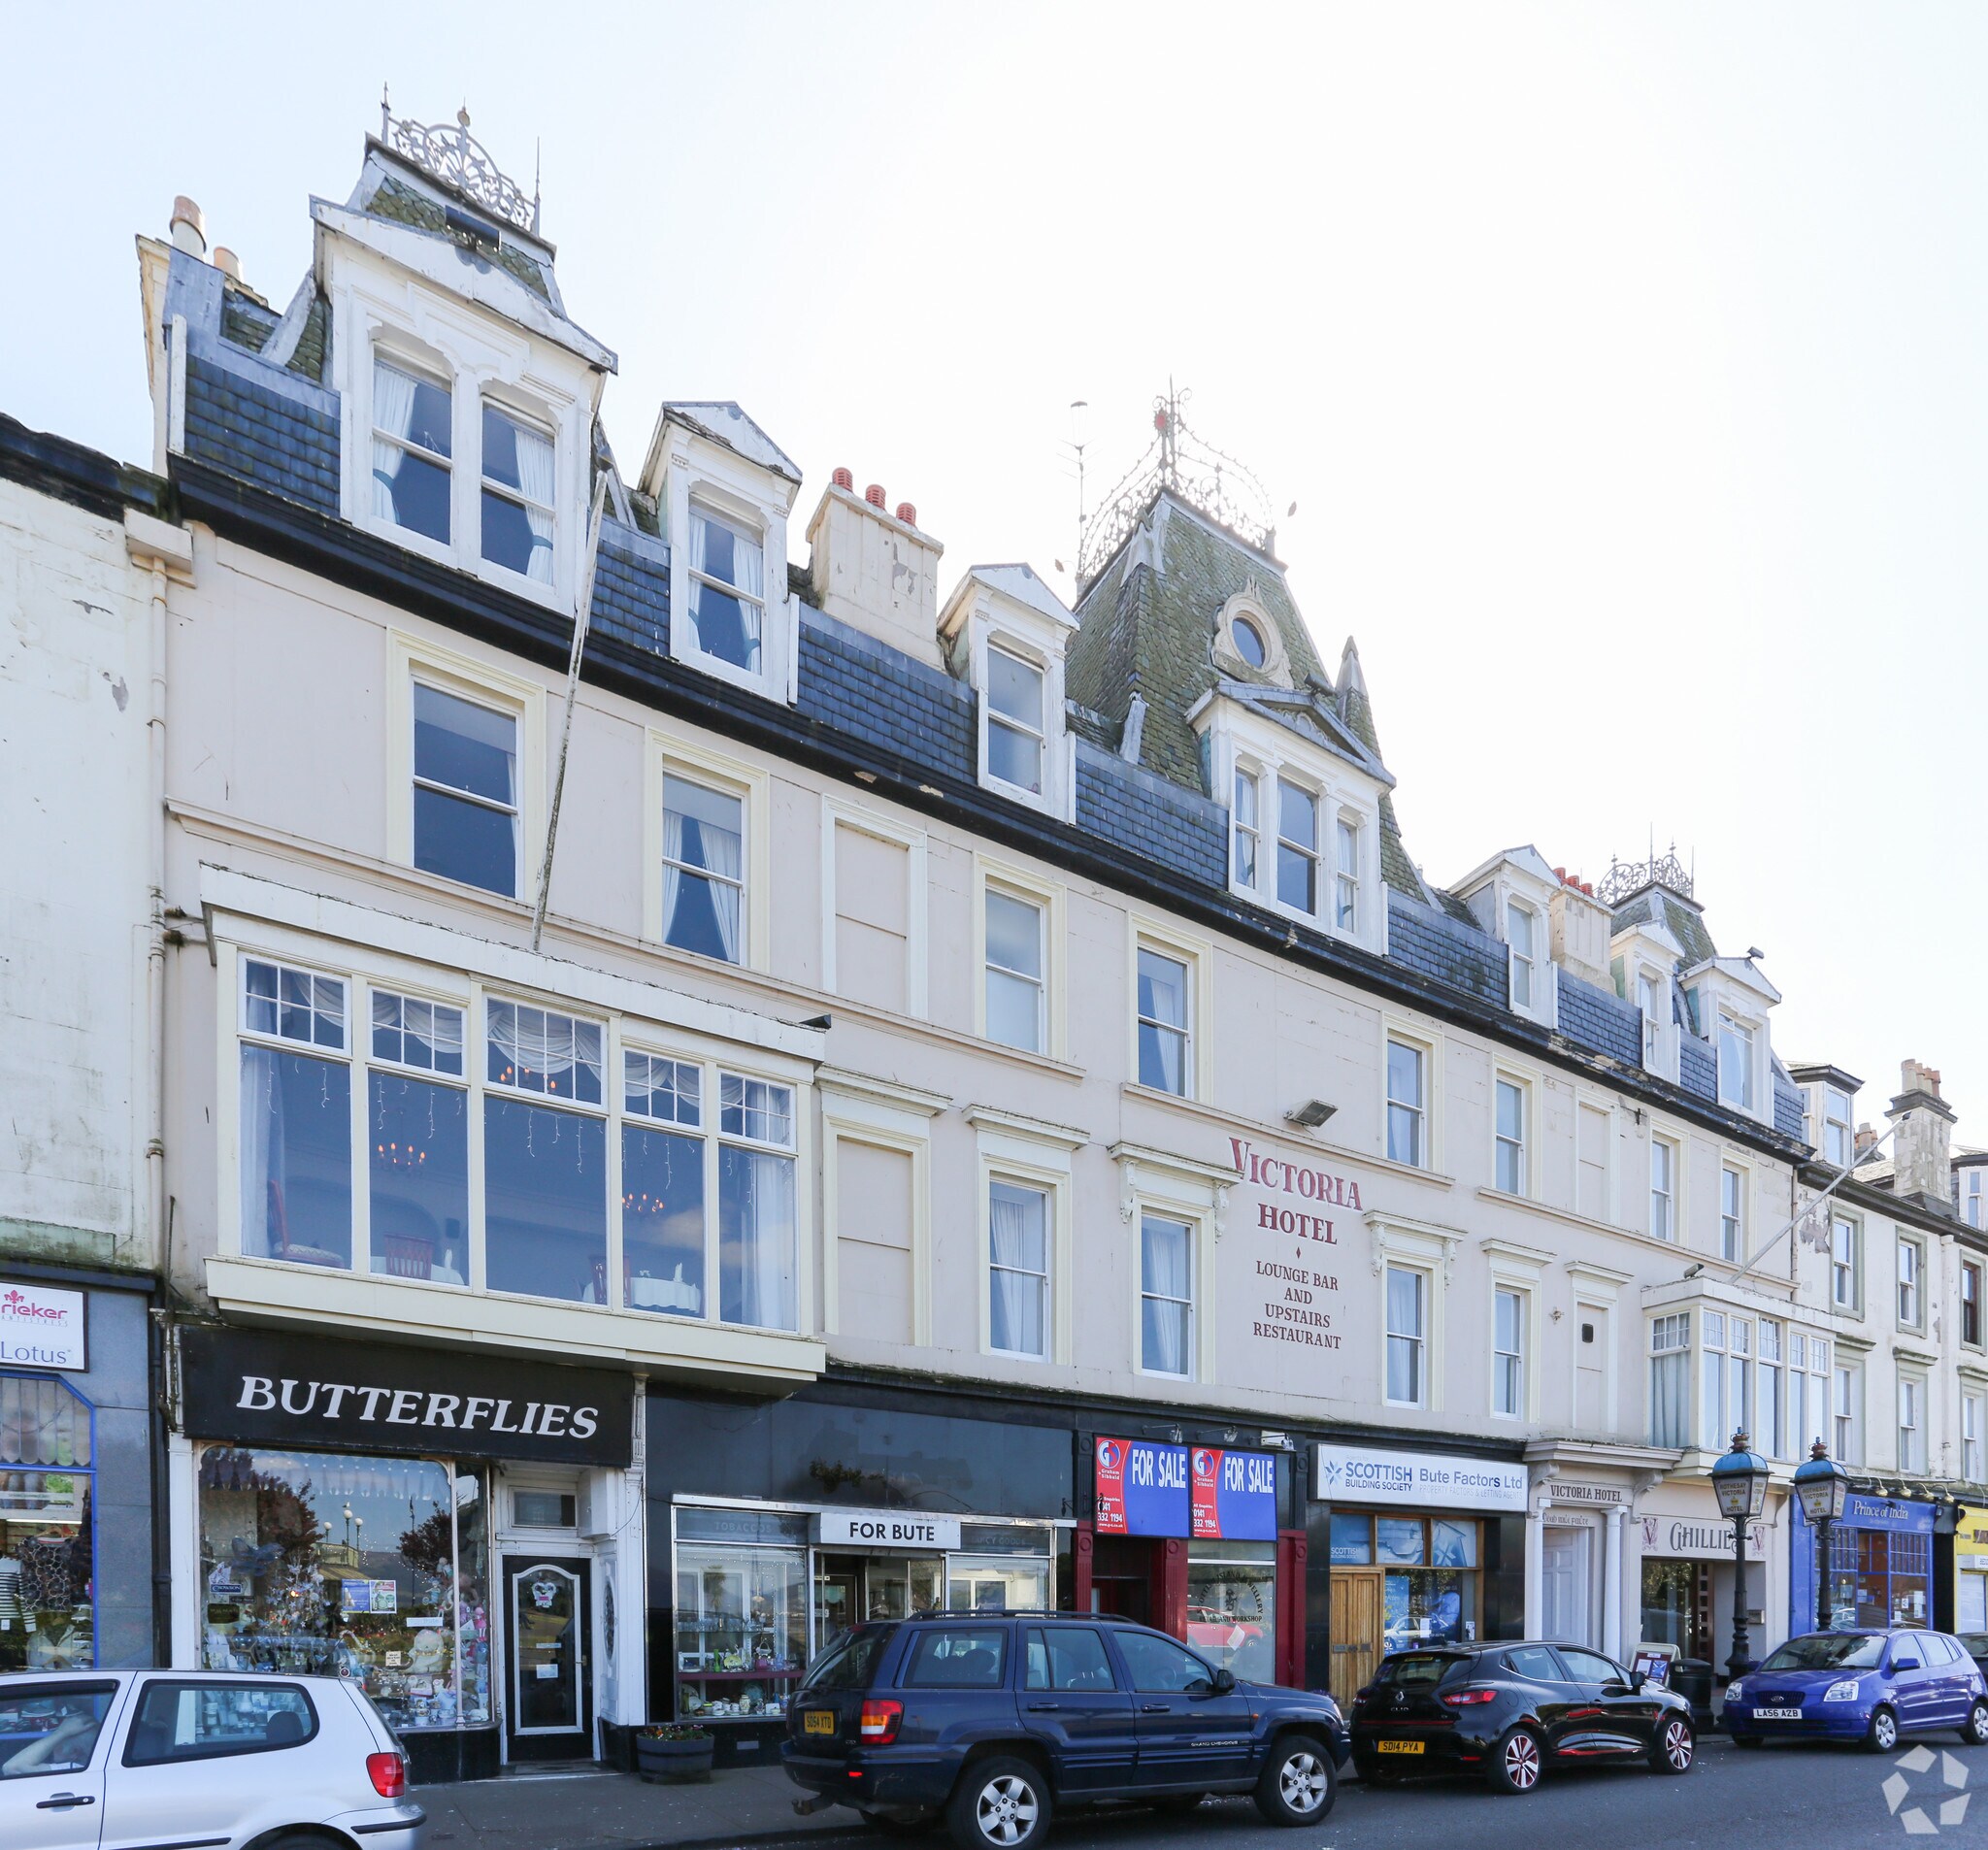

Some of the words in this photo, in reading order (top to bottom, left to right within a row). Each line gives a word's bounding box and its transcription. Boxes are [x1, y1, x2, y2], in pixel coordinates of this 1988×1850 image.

[1229, 1137, 1363, 1211] VICTORIA
[1257, 1203, 1338, 1245] HOTEL
[1256, 1260, 1309, 1284] LOUNGE
[1312, 1272, 1339, 1291] BAR
[1283, 1287, 1312, 1305] AND
[1, 1303, 68, 1319] rieker
[1265, 1303, 1331, 1329] UPSTAIRS
[1253, 1321, 1342, 1349] RESTAURANT
[1, 1341, 67, 1364] Lotus
[236, 1375, 599, 1439] BUTTERFLIES
[1132, 1449, 1154, 1486] FOR
[1158, 1451, 1186, 1488] SALE
[1224, 1457, 1244, 1492] FOR
[1247, 1458, 1274, 1494] SALE
[1345, 1461, 1412, 1482] SCOTTISH
[1419, 1468, 1449, 1484] Bute
[1454, 1470, 1501, 1488] Factors
[1504, 1475, 1523, 1489] Ltd
[1345, 1478, 1380, 1490] BUILDING
[1381, 1481, 1412, 1492] SOCIETY
[1419, 1484, 1447, 1495] PROPERTY
[1449, 1486, 1474, 1497] FACTORS
[1480, 1489, 1503, 1499] LETTING
[1503, 1491, 1523, 1501] AGENTS
[1550, 1484, 1593, 1500] VICTORIA
[1594, 1488, 1623, 1503] HOTEL
[1097, 1502, 1110, 1511] 041
[1193, 1508, 1206, 1517] 0141
[1853, 1500, 1880, 1517] Prince
[1880, 1506, 1889, 1518] of
[1889, 1504, 1908, 1520] India
[714, 1521, 772, 1533] TOBACCOS
[1097, 1511, 1109, 1522] 332
[1110, 1512, 1123, 1523] 1194
[1193, 1518, 1204, 1528] 332
[1204, 1519, 1216, 1529] 1194
[849, 1521, 886, 1539] FOR
[892, 1524, 935, 1541] BUTE
[1383, 1741, 1401, 1751] SD14
[1402, 1741, 1419, 1751] PYA
